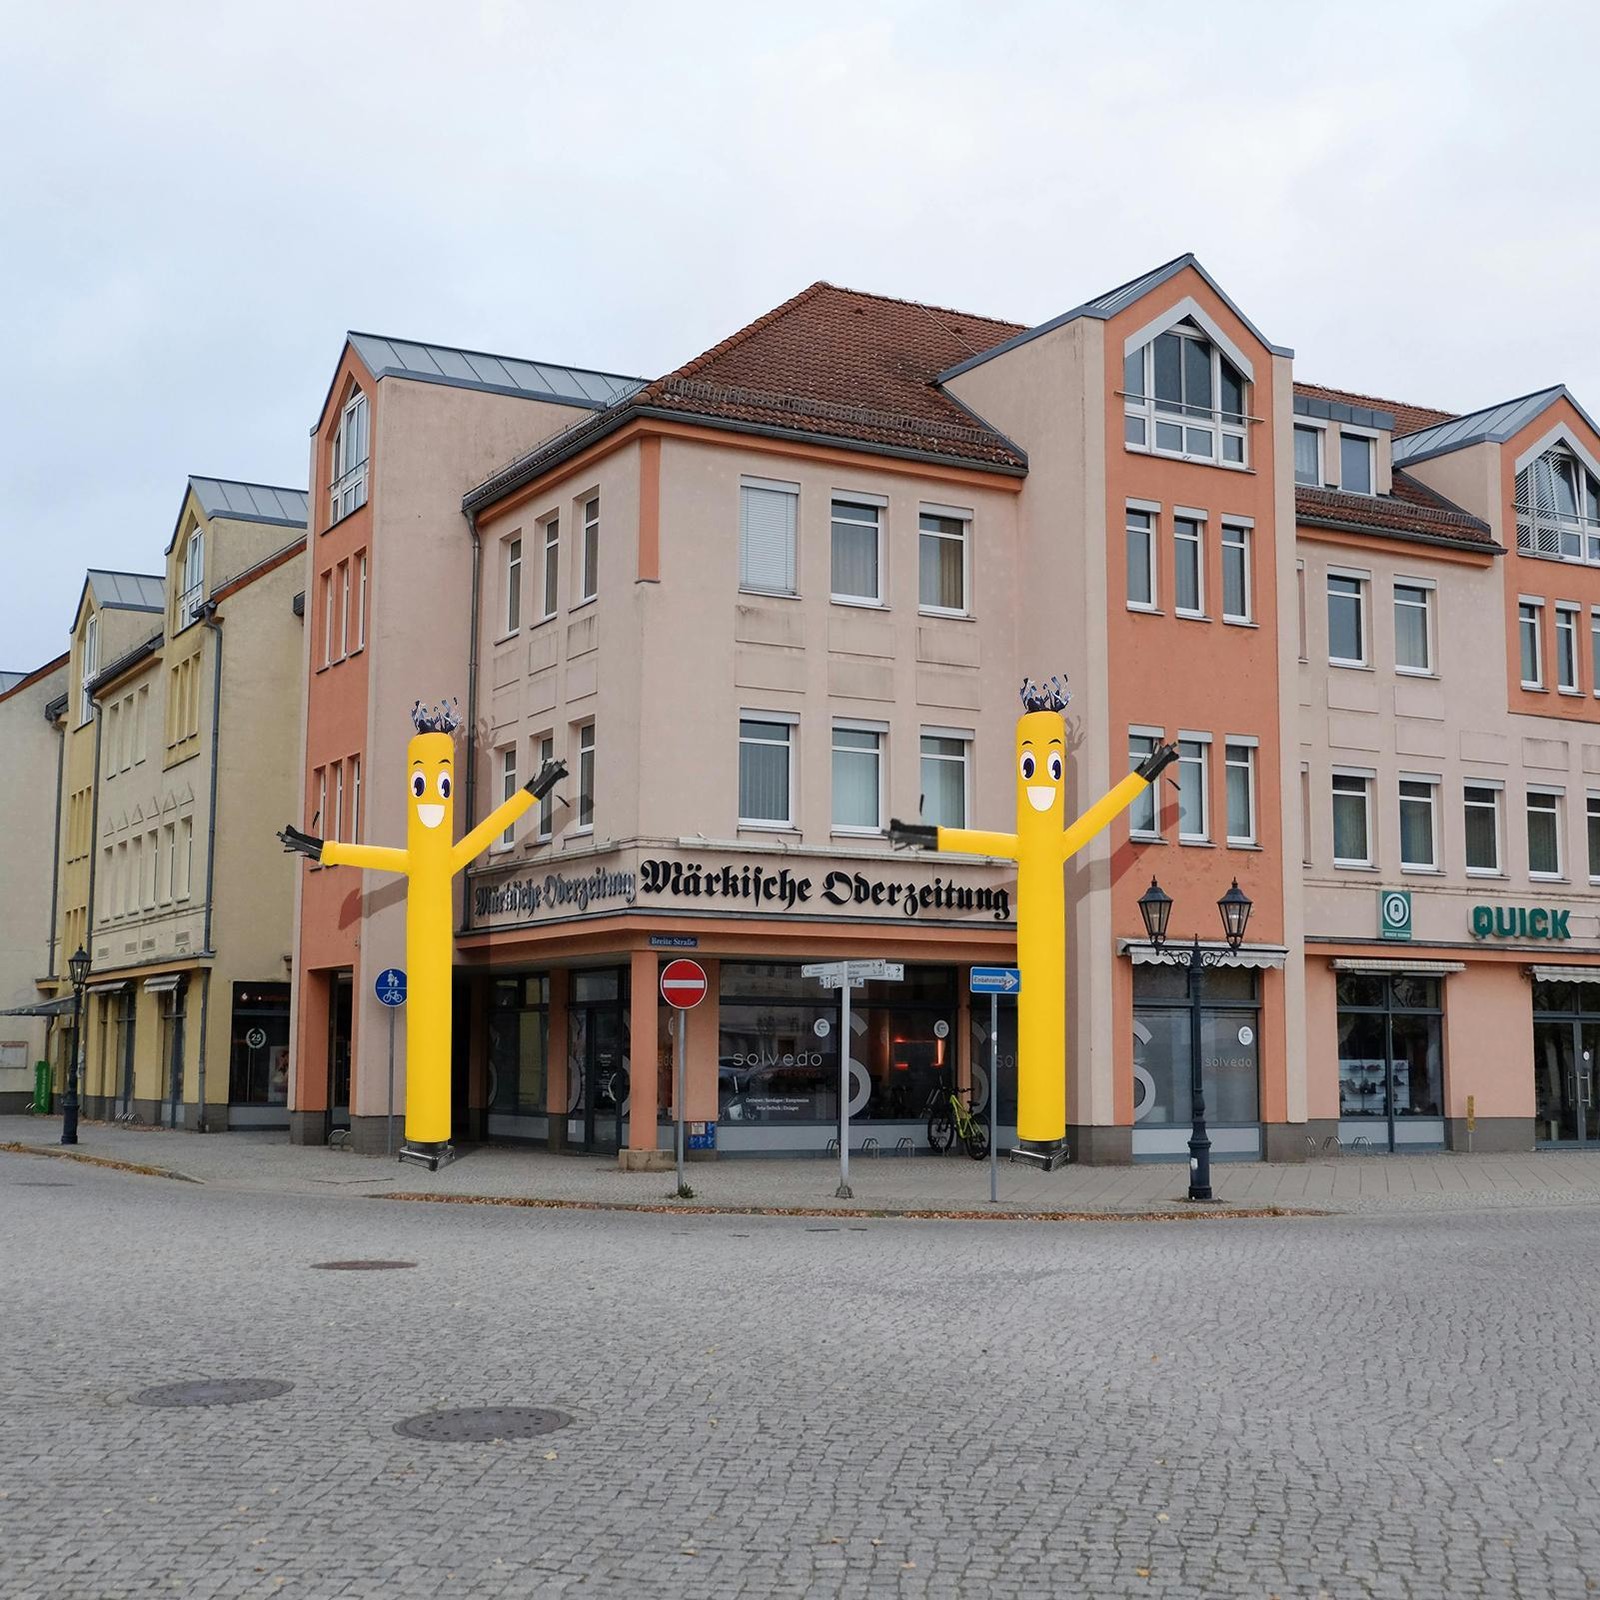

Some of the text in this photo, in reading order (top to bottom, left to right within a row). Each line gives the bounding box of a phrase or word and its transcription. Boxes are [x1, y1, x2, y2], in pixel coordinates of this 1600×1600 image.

[822, 870, 1011, 921] Oderzeitung
[1472, 905, 1572, 940] QUICK
[651, 936, 672, 945] Breite
[732, 1049, 823, 1067] solvedo
[1204, 1056, 1252, 1068] solvedo
